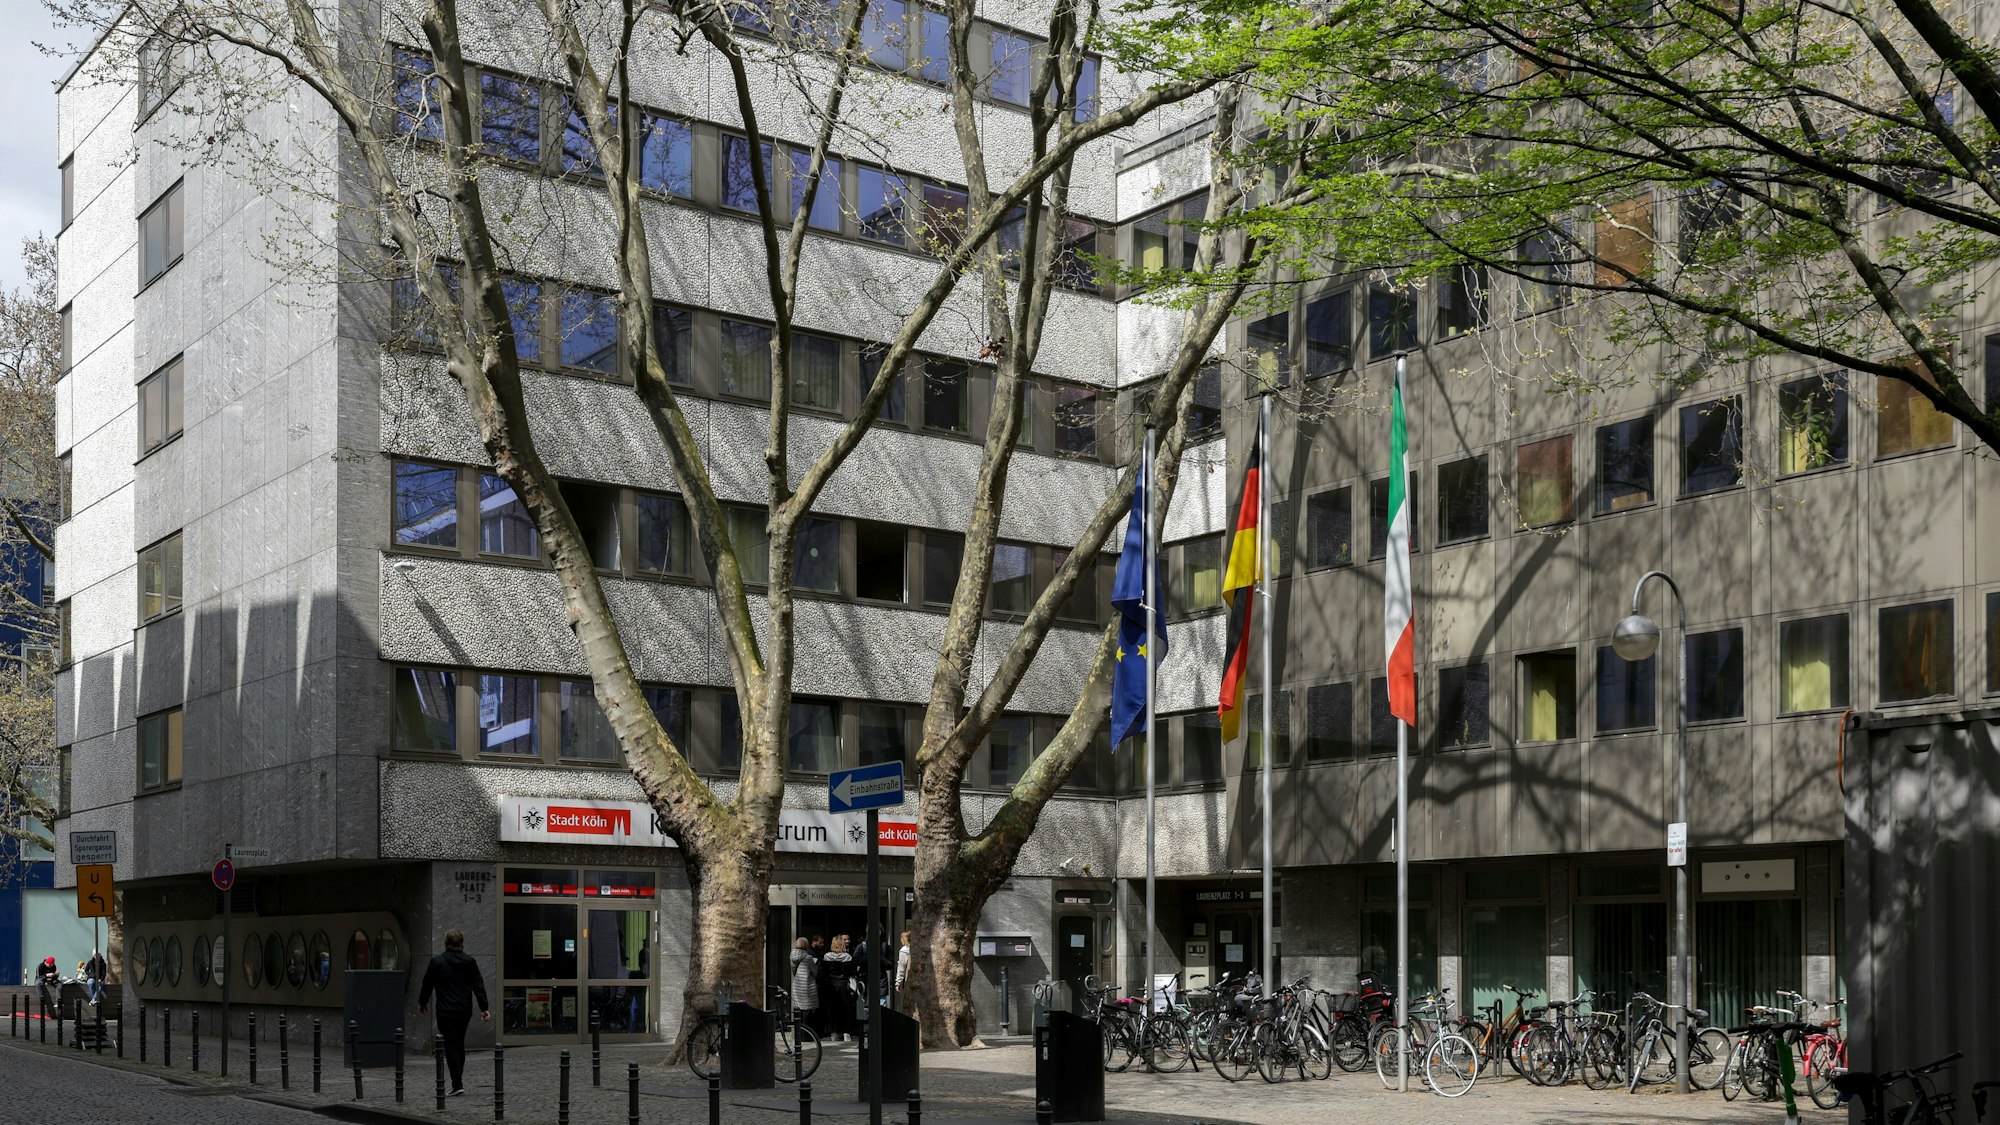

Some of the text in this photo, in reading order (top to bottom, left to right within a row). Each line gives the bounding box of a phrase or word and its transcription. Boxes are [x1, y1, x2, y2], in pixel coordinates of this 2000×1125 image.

[849, 779, 899, 796] Einbahnstraße
[549, 813, 608, 830] Stadt Köln
[76, 834, 110, 843] Durchfahrt
[879, 828, 918, 842] adt Köln
[74, 844, 113, 854] Sporergasse
[234, 848, 268, 858] Laurenzplatz
[76, 852, 112, 862] gesperrt
[90, 872, 100, 885] U
[455, 871, 497, 882] LAURENZ-
[460, 882, 486, 893] PLATZ
[811, 891, 863, 901] Kundenzentrum
[1196, 891, 1231, 901] LAURENZPLATZ
